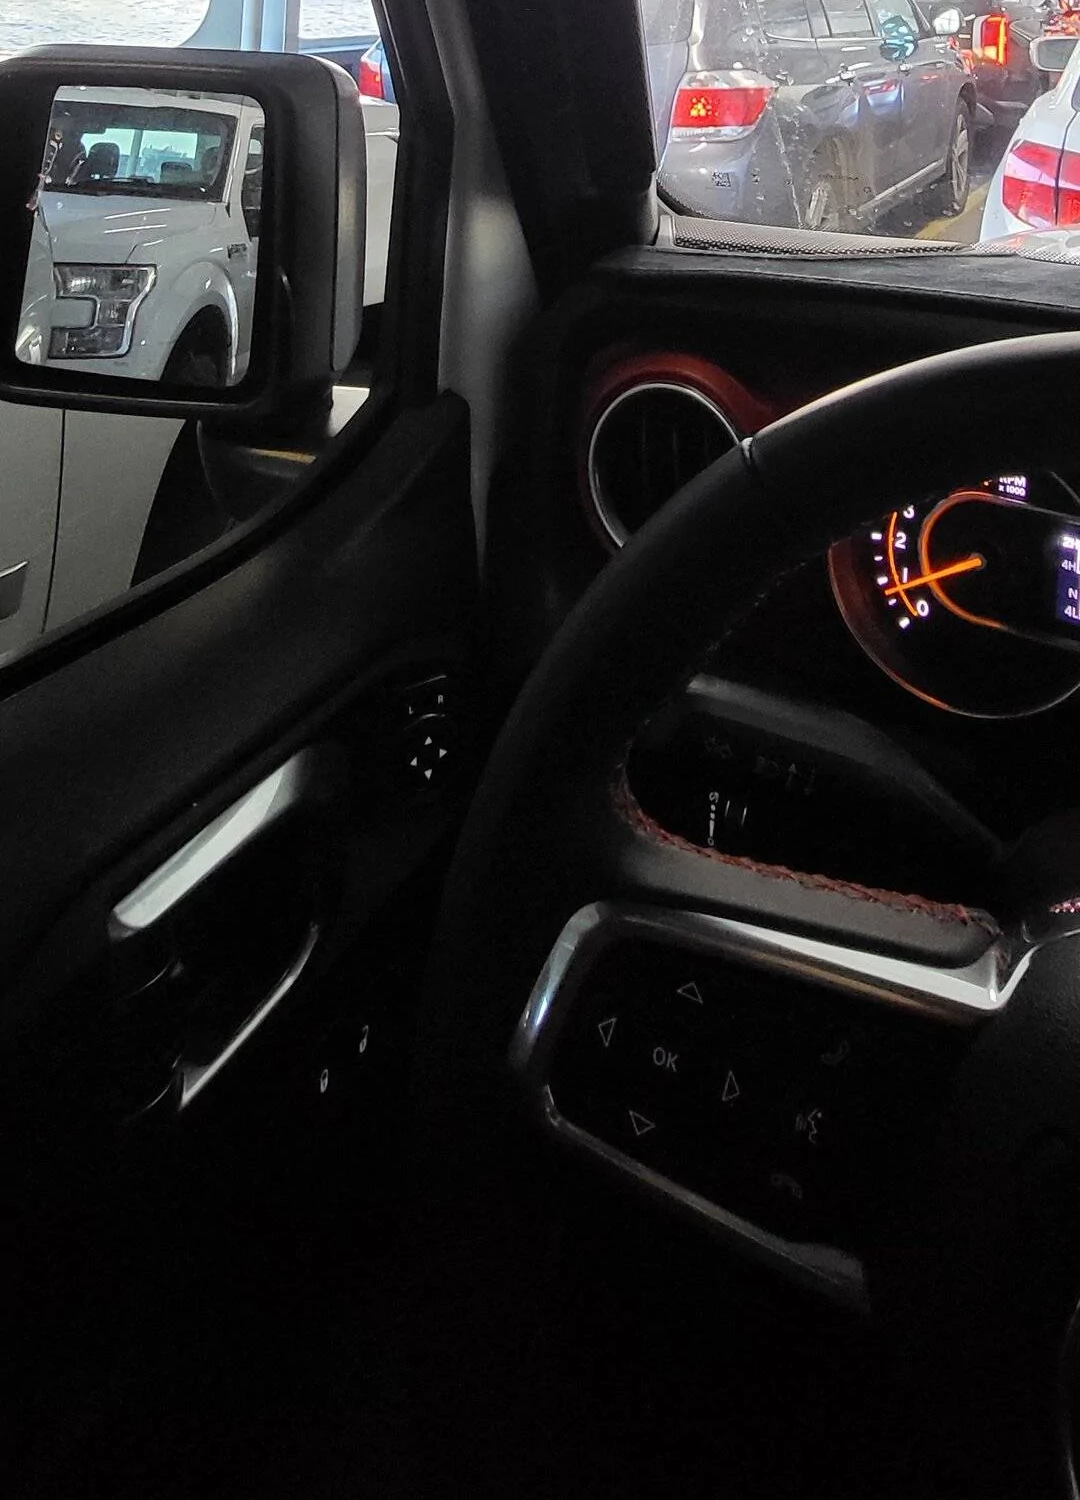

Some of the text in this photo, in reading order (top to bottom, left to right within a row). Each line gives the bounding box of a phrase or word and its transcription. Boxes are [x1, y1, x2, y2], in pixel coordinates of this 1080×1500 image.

[1006, 485, 1026, 497] 1000
[894, 531, 907, 550] 2
[916, 598, 930, 617] 0
[652, 1046, 679, 1073] OK
